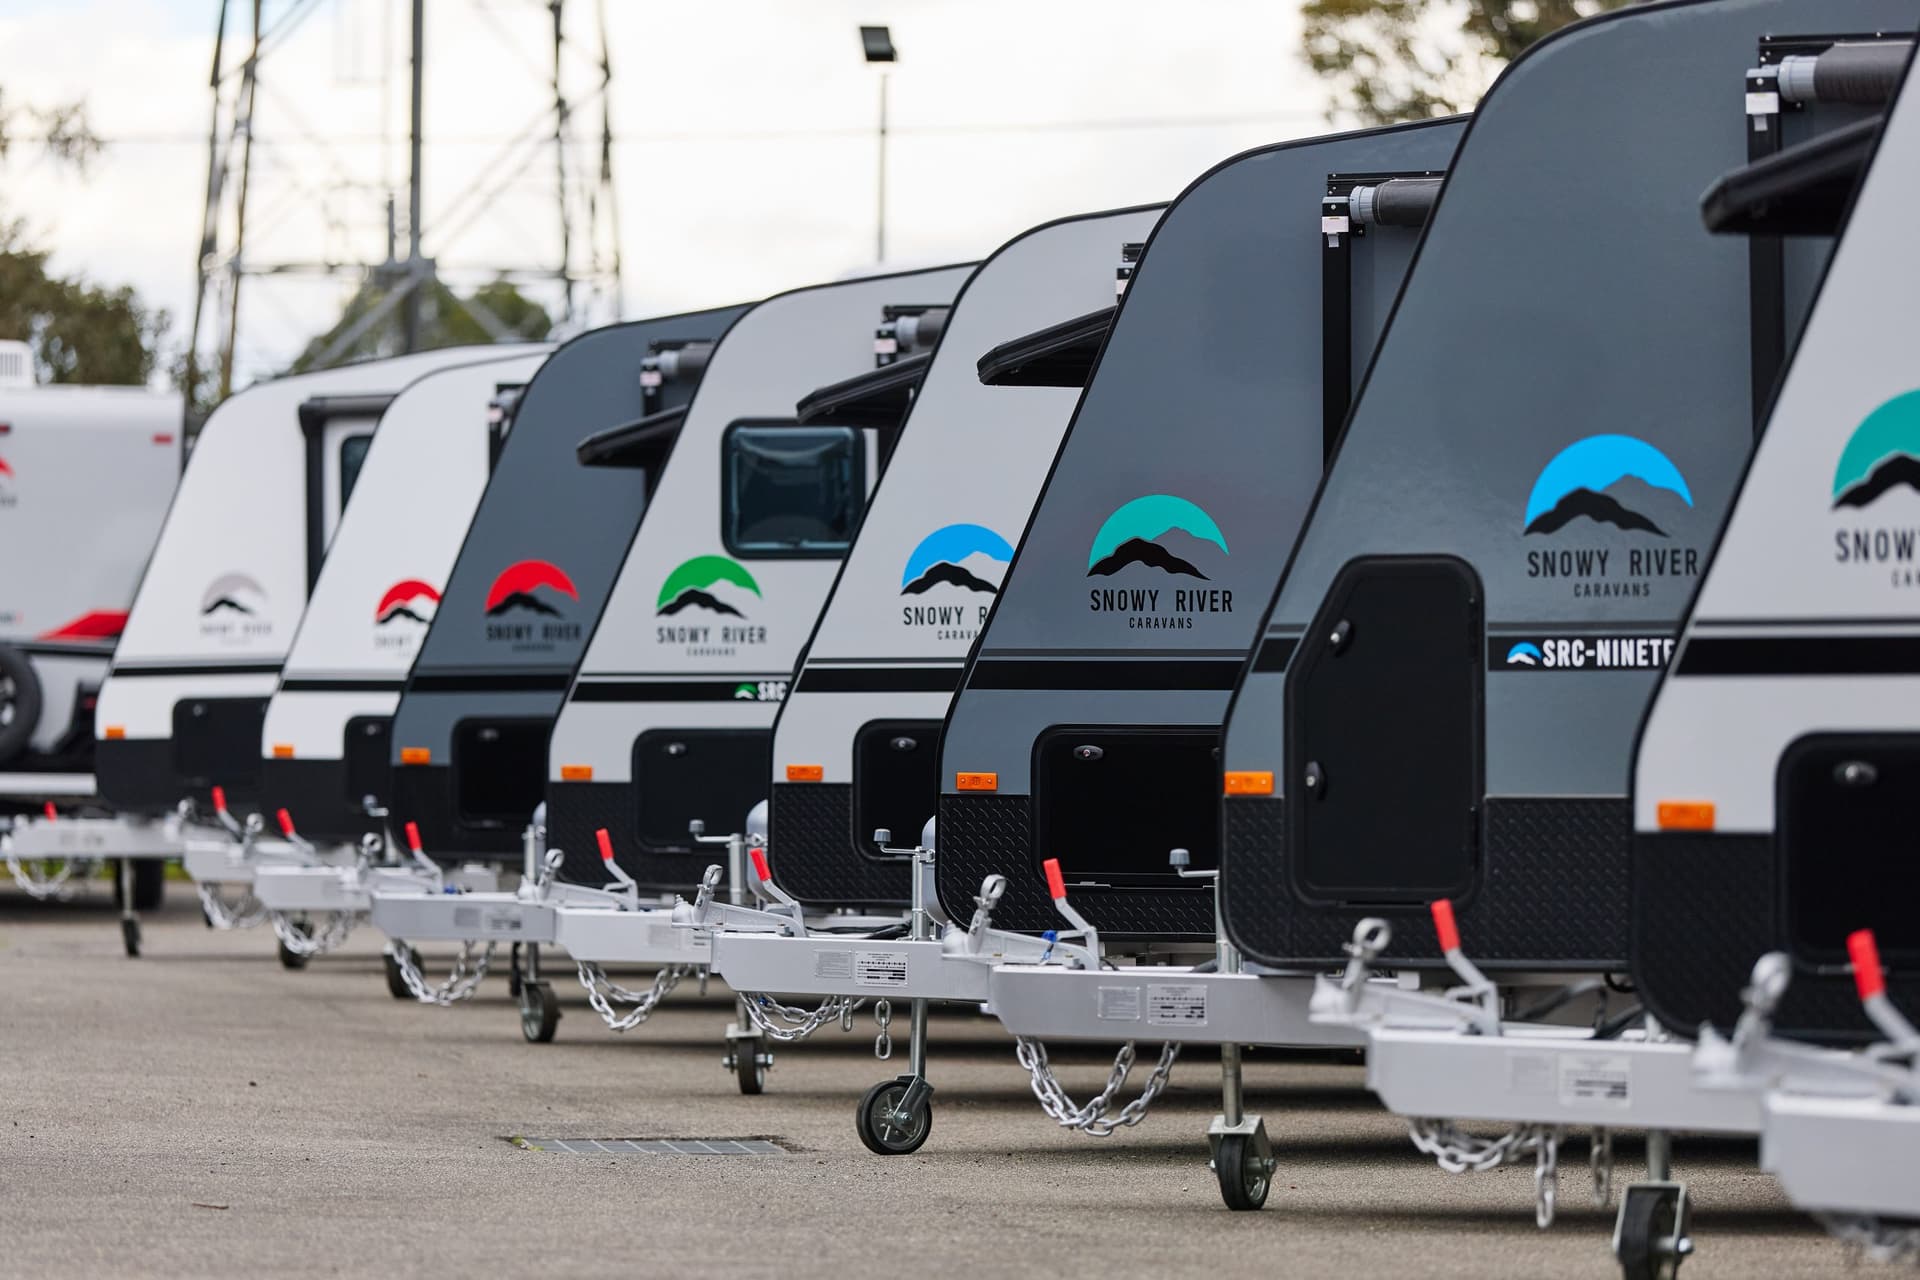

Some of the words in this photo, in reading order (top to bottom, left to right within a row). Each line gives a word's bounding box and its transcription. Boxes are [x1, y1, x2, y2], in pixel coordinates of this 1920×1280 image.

[1834, 527, 1920, 563] SNOW
[1527, 549, 1609, 577] SNOWY
[1630, 548, 1698, 576] RIVER
[1573, 582, 1651, 598] CARAVANS
[1090, 589, 1159, 611] SNOWY
[1175, 589, 1233, 612] RIVER
[903, 605, 964, 625] SNOWY
[1129, 617, 1193, 629] CARAVANS
[656, 626, 710, 644] SNOWY
[721, 626, 767, 644] RIVER
